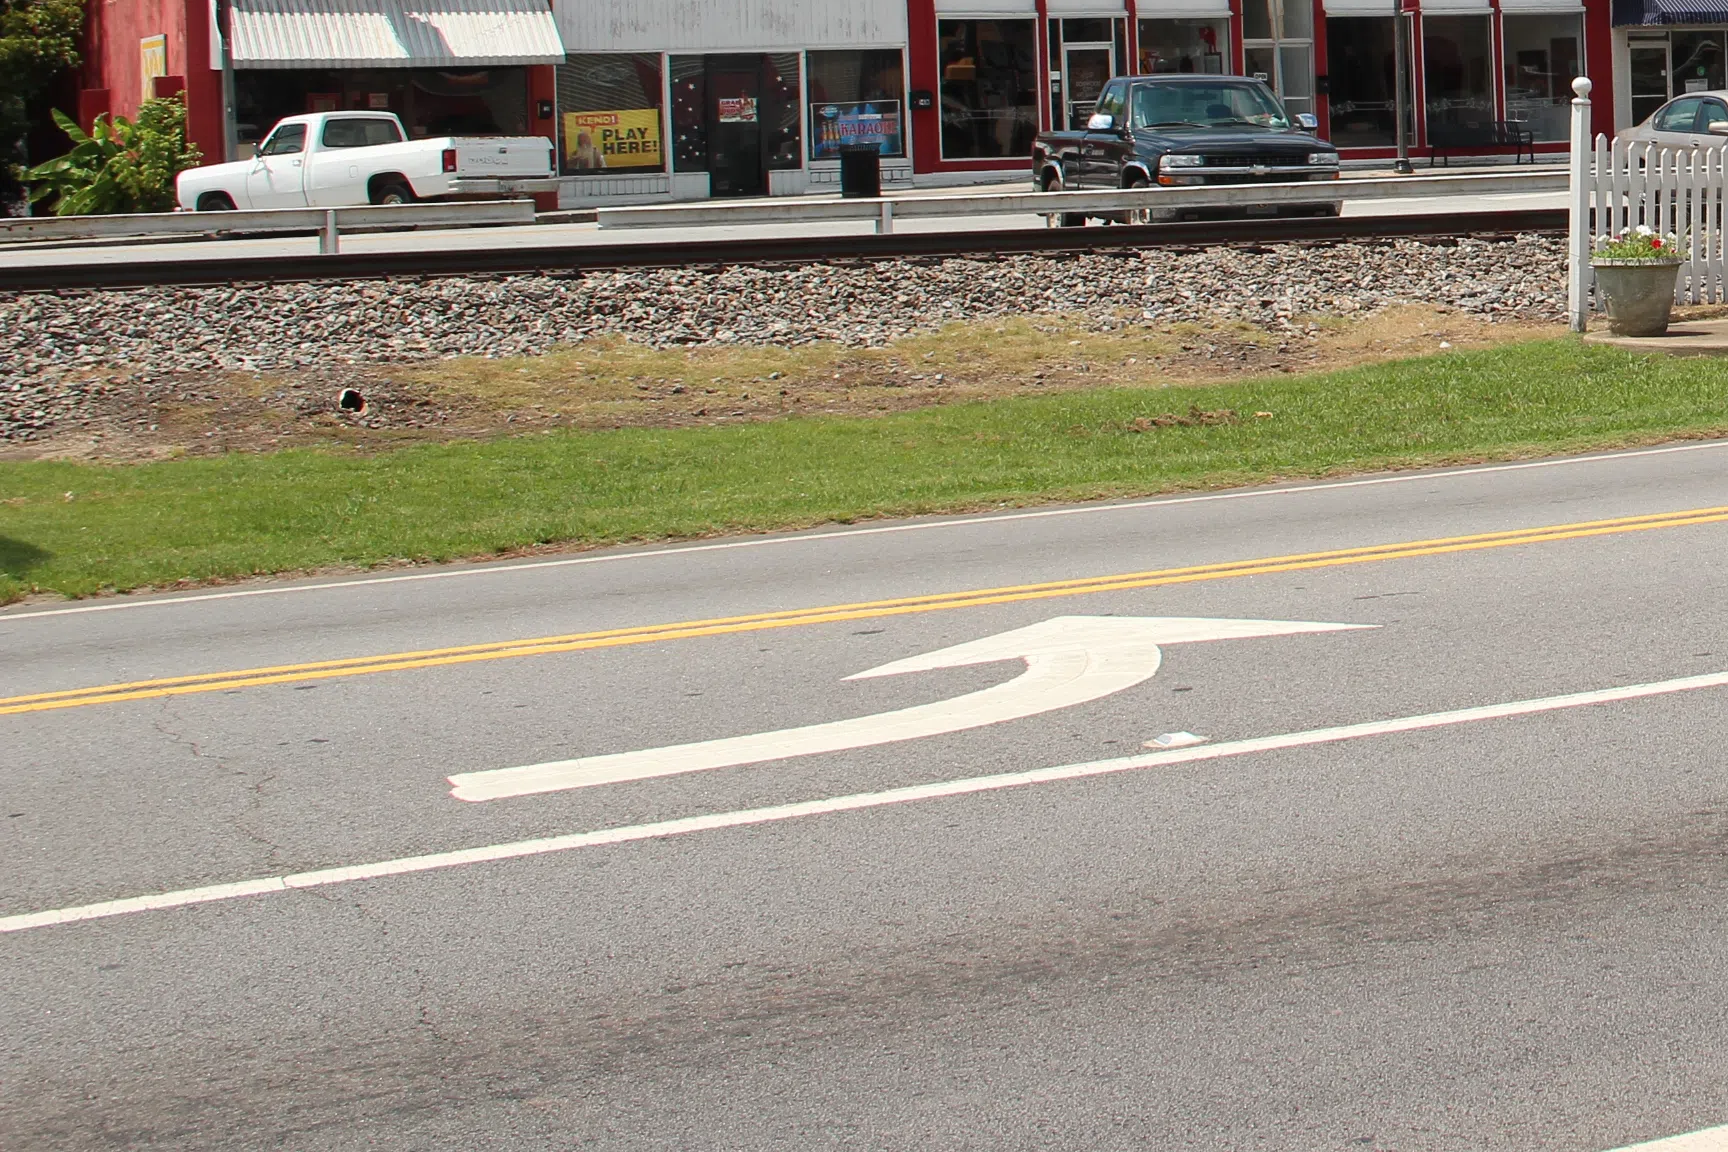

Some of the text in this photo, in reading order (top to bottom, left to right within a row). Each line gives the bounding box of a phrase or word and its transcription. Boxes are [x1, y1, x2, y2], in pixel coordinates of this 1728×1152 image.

[579, 115, 616, 124] KENO!
[602, 127, 648, 141] PLAY
[840, 121, 896, 136] KARAOKE
[603, 140, 658, 155] HERE!
